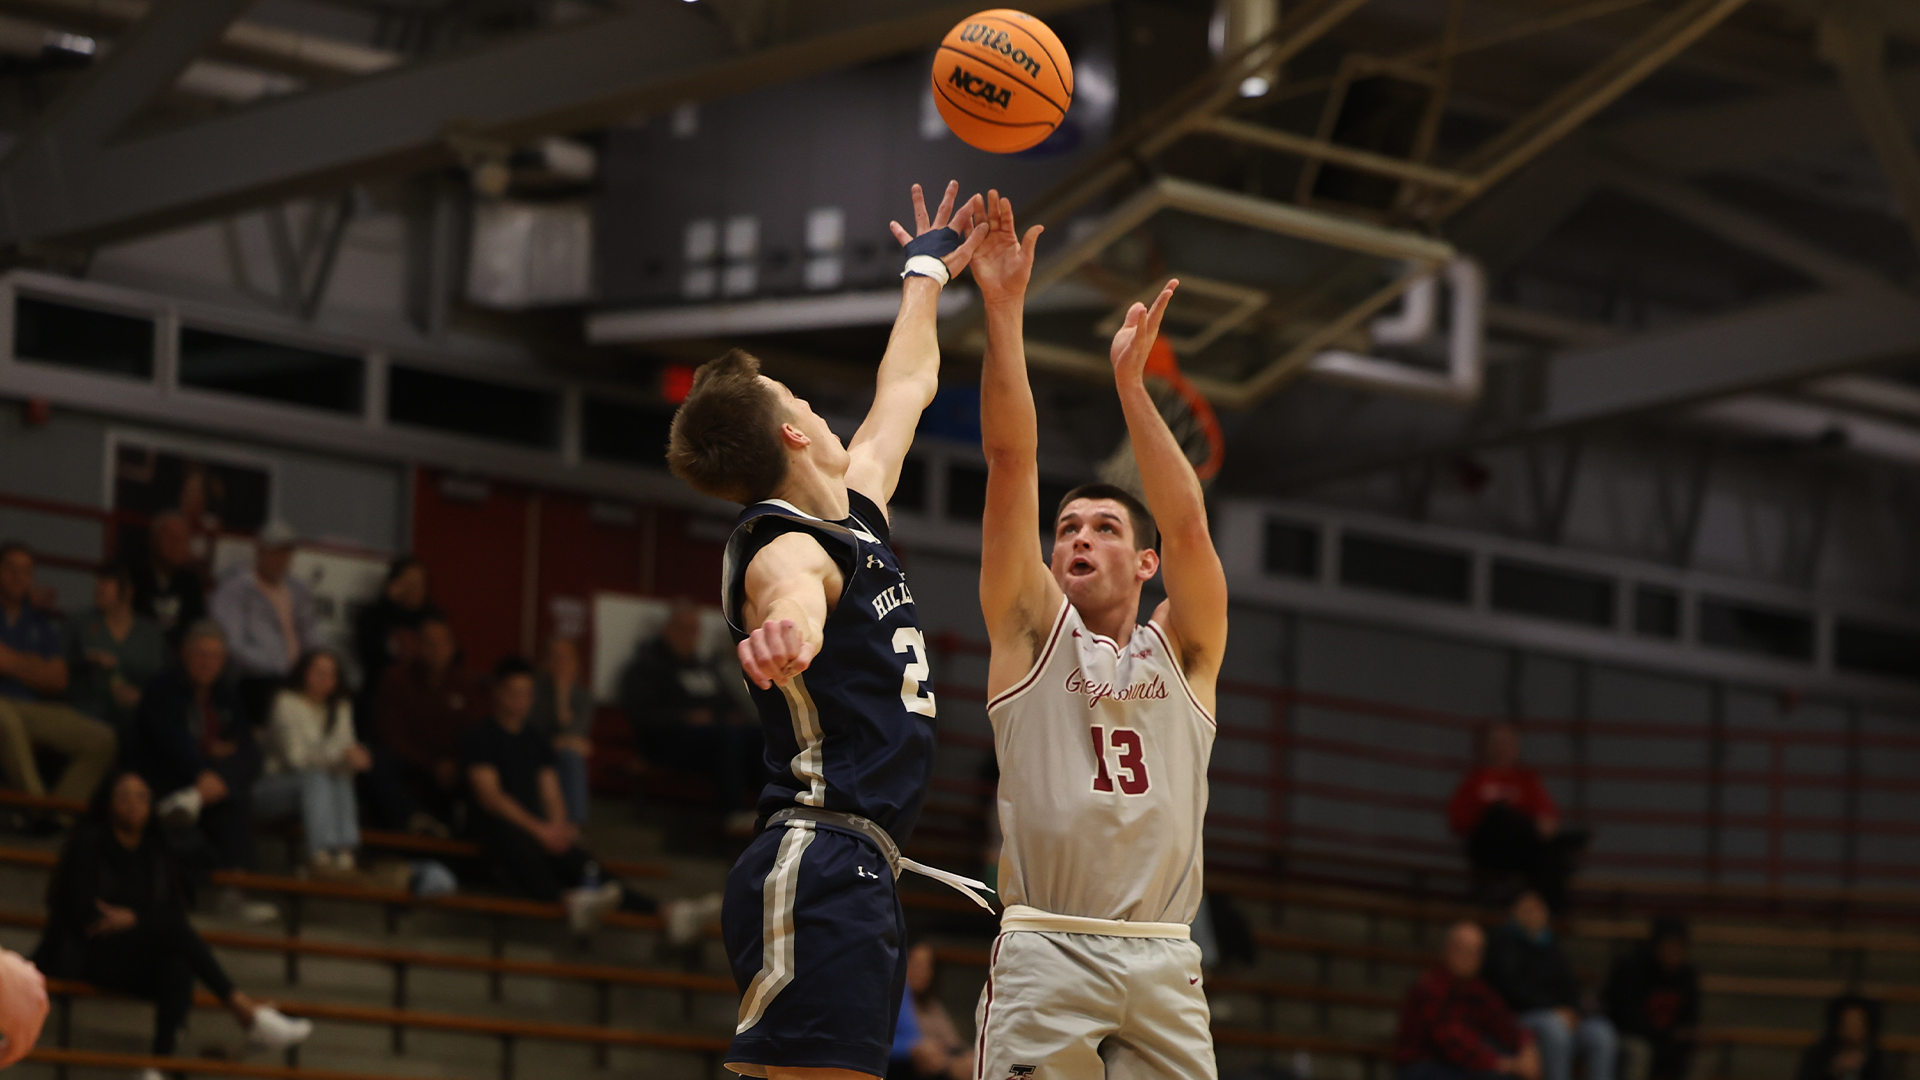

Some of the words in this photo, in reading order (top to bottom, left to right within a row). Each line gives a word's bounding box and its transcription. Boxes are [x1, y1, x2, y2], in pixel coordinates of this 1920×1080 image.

[960, 23, 1041, 80] Wilson
[949, 65, 1012, 110] NCAA
[871, 582, 915, 621] HILL
[1090, 724, 1152, 797] 13
